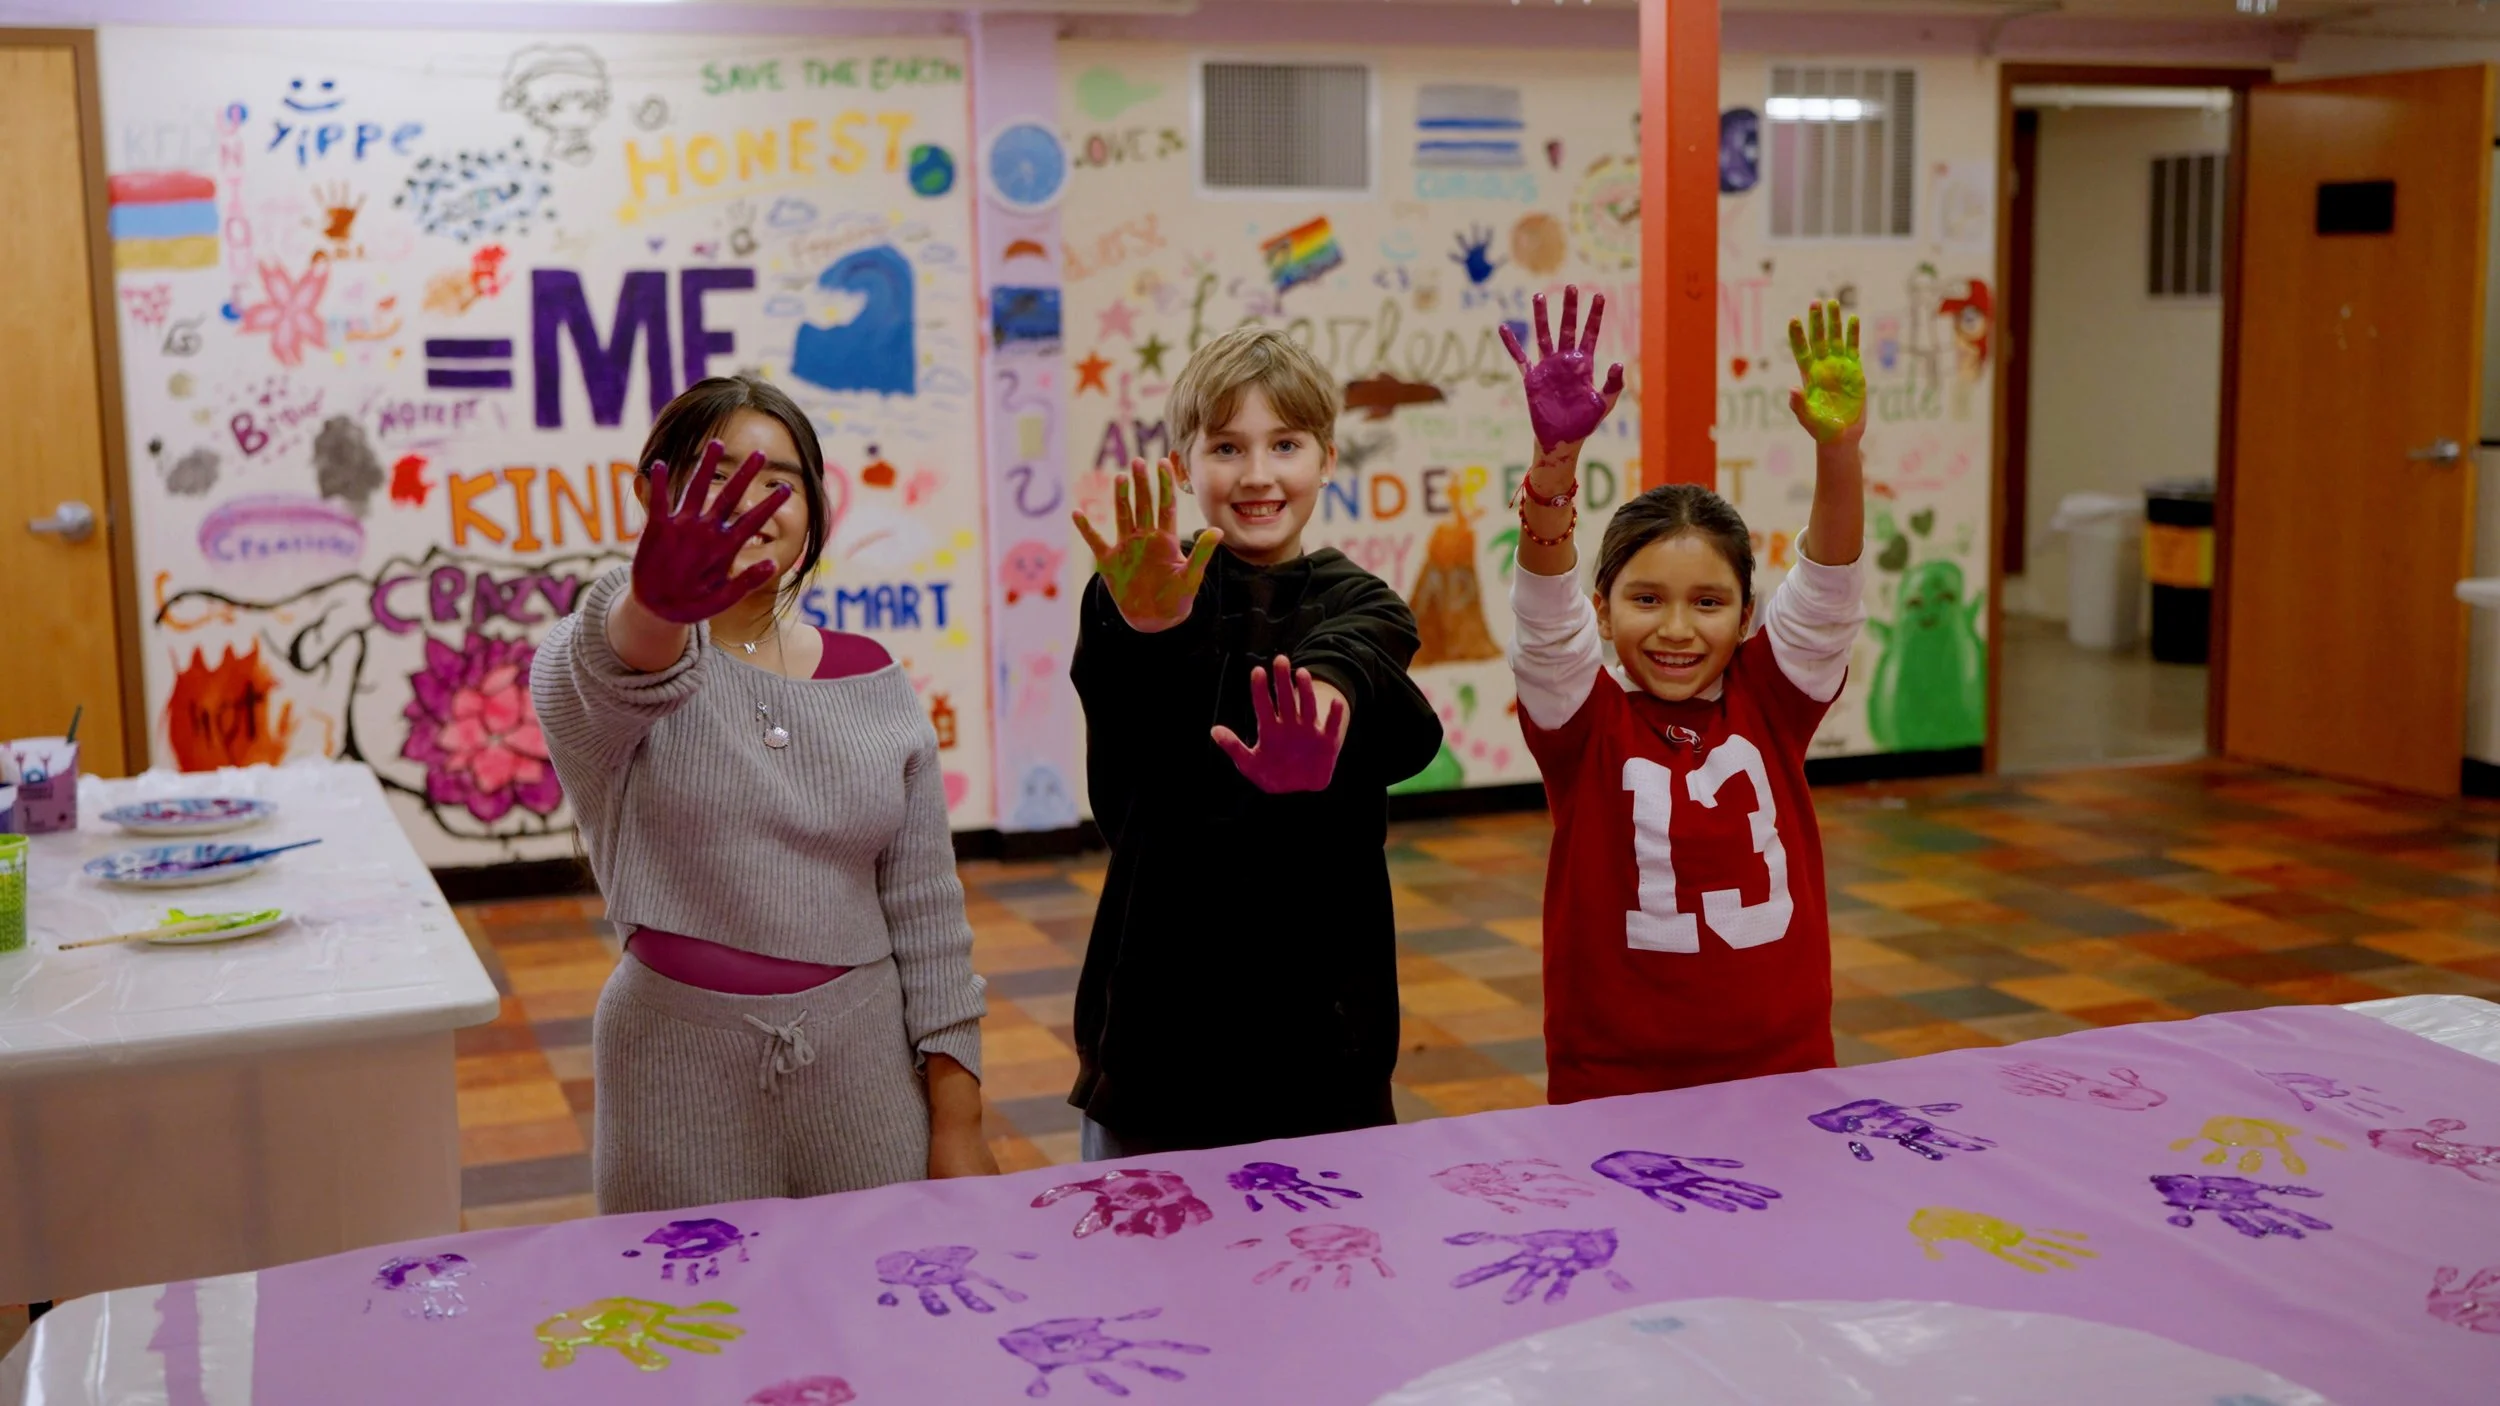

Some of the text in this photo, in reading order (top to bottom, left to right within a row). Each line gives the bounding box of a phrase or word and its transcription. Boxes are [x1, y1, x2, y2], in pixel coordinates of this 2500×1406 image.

[702, 55, 963, 95] SAVE THE EARTH
[624, 111, 914, 200] HONEST
[447, 457, 645, 552] KIND
[370, 564, 580, 634] CRAZY
[801, 582, 952, 629] SMART
[1622, 733, 1794, 953] 13
